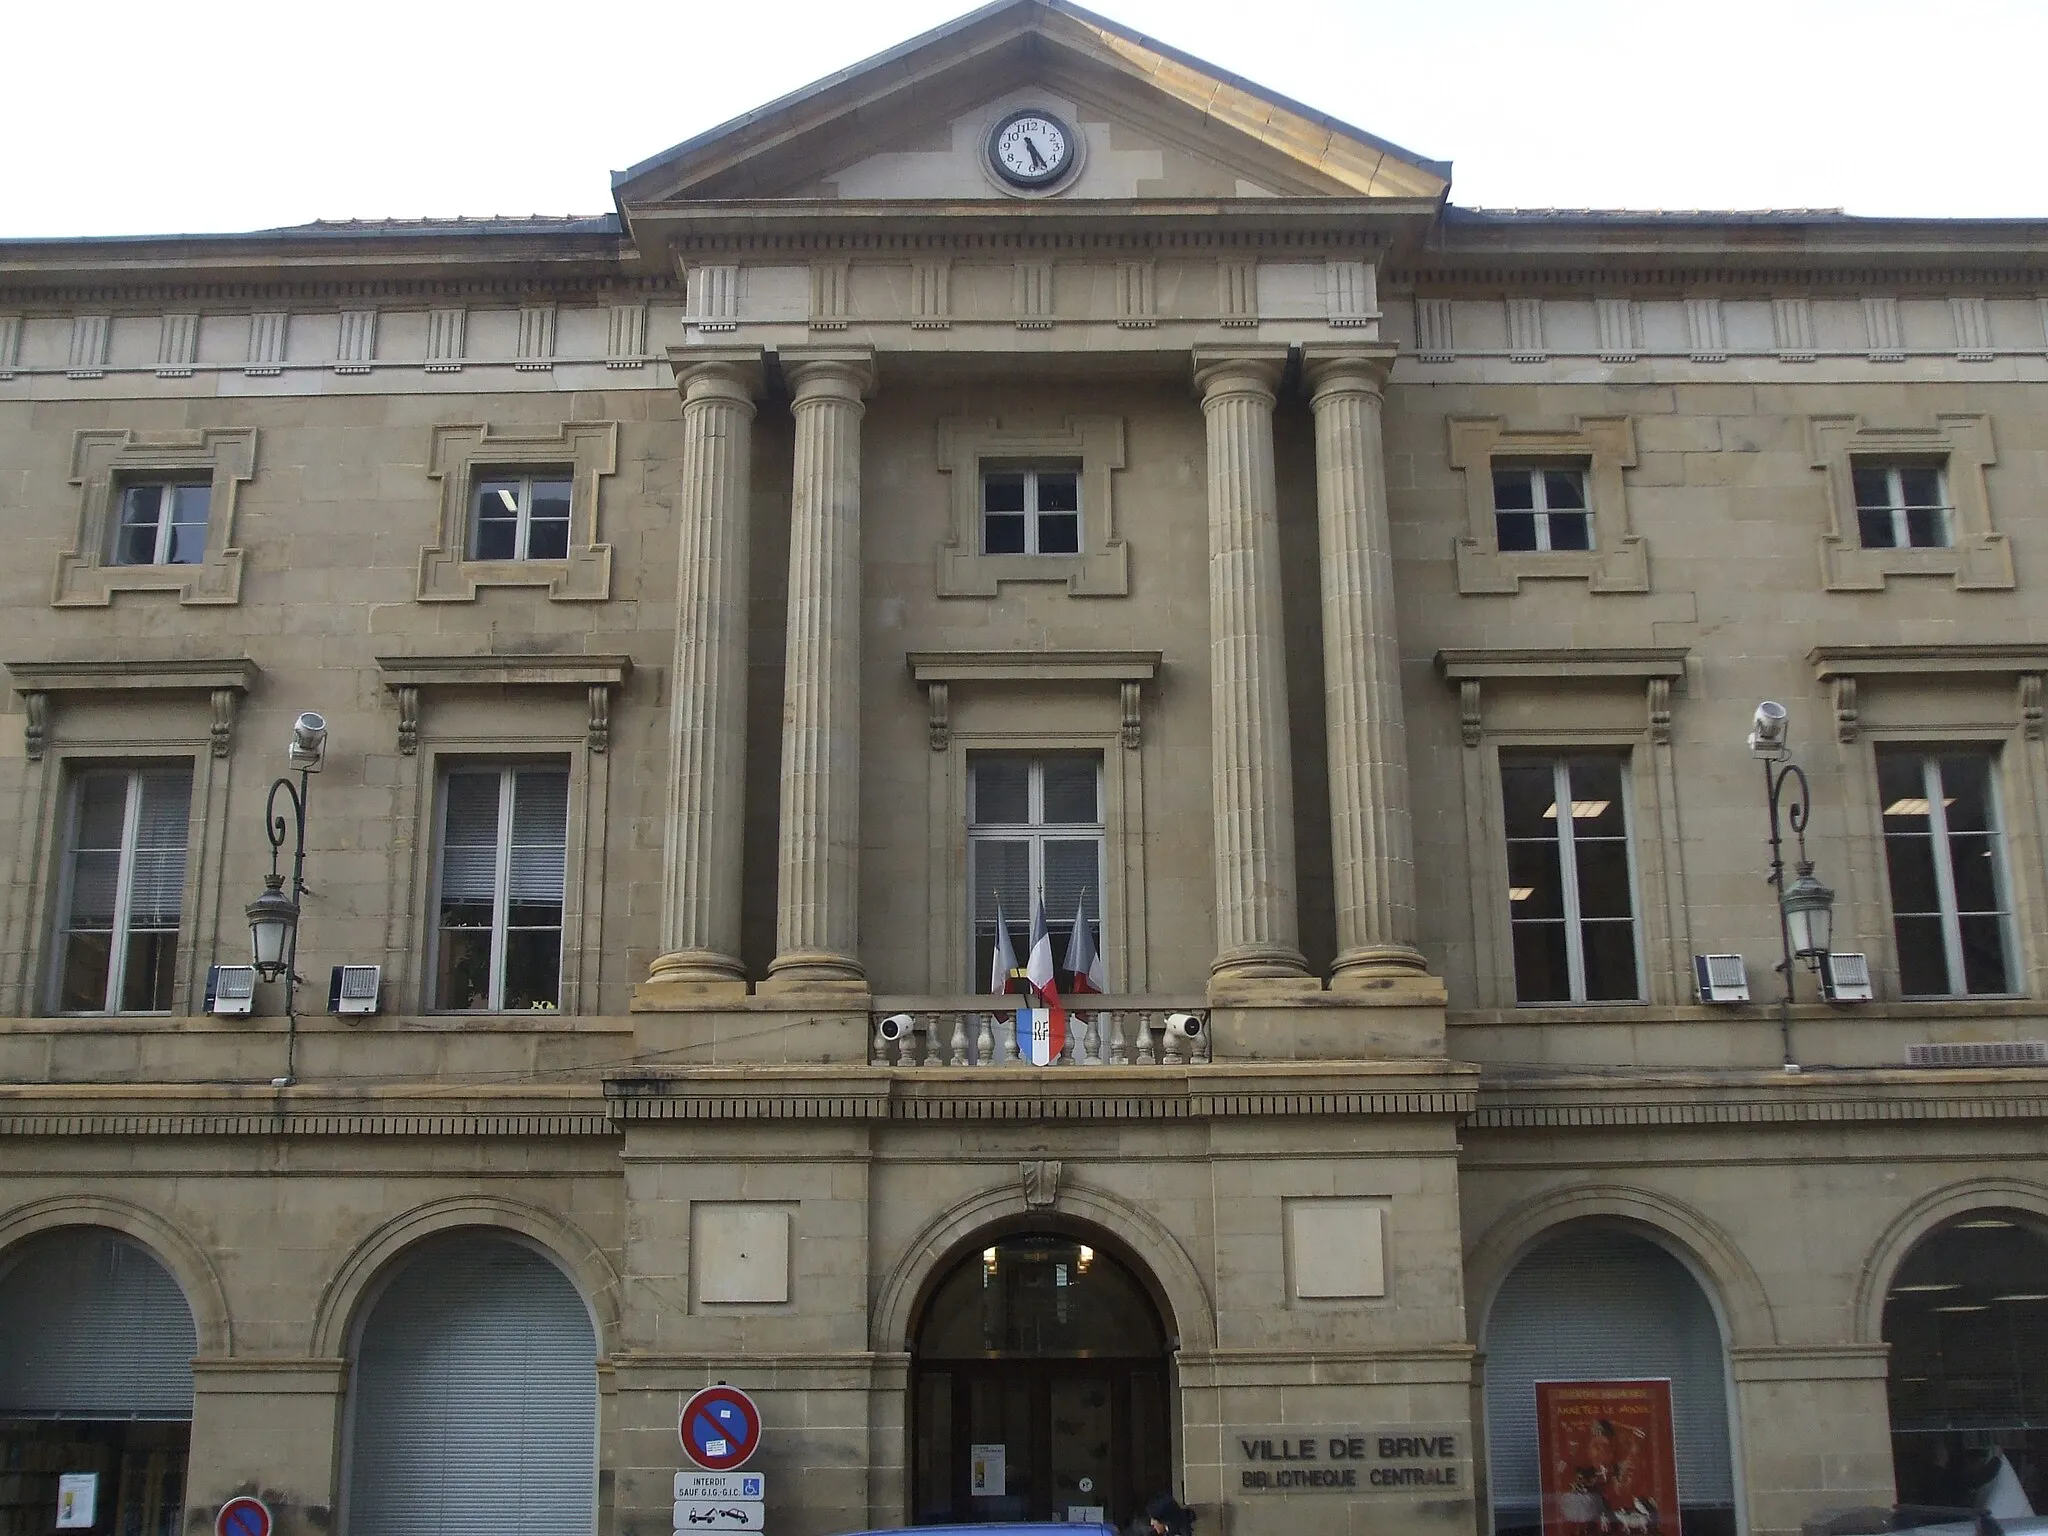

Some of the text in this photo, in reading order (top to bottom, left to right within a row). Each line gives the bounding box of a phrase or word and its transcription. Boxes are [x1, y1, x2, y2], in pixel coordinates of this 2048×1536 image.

[1017, 125, 1026, 133] 11
[1026, 122, 1038, 131] 12
[1041, 126, 1046, 134] 1
[1008, 132, 1019, 141] 10
[1050, 133, 1056, 142] 2
[1003, 143, 1010, 151] 9
[1053, 143, 1060, 152] 3
[1007, 153, 1014, 162] 8
[1050, 154, 1057, 163] 4
[1016, 161, 1022, 169] 7
[1029, 164, 1036, 172] 6
[1034, 1020, 1048, 1040] RF
[1241, 1437, 1455, 1461] VILLE DE BRIVE
[693, 1478, 726, 1486] INTERDIT
[1241, 1467, 1457, 1488] BIBLIOTHEQUE CENTRALE
